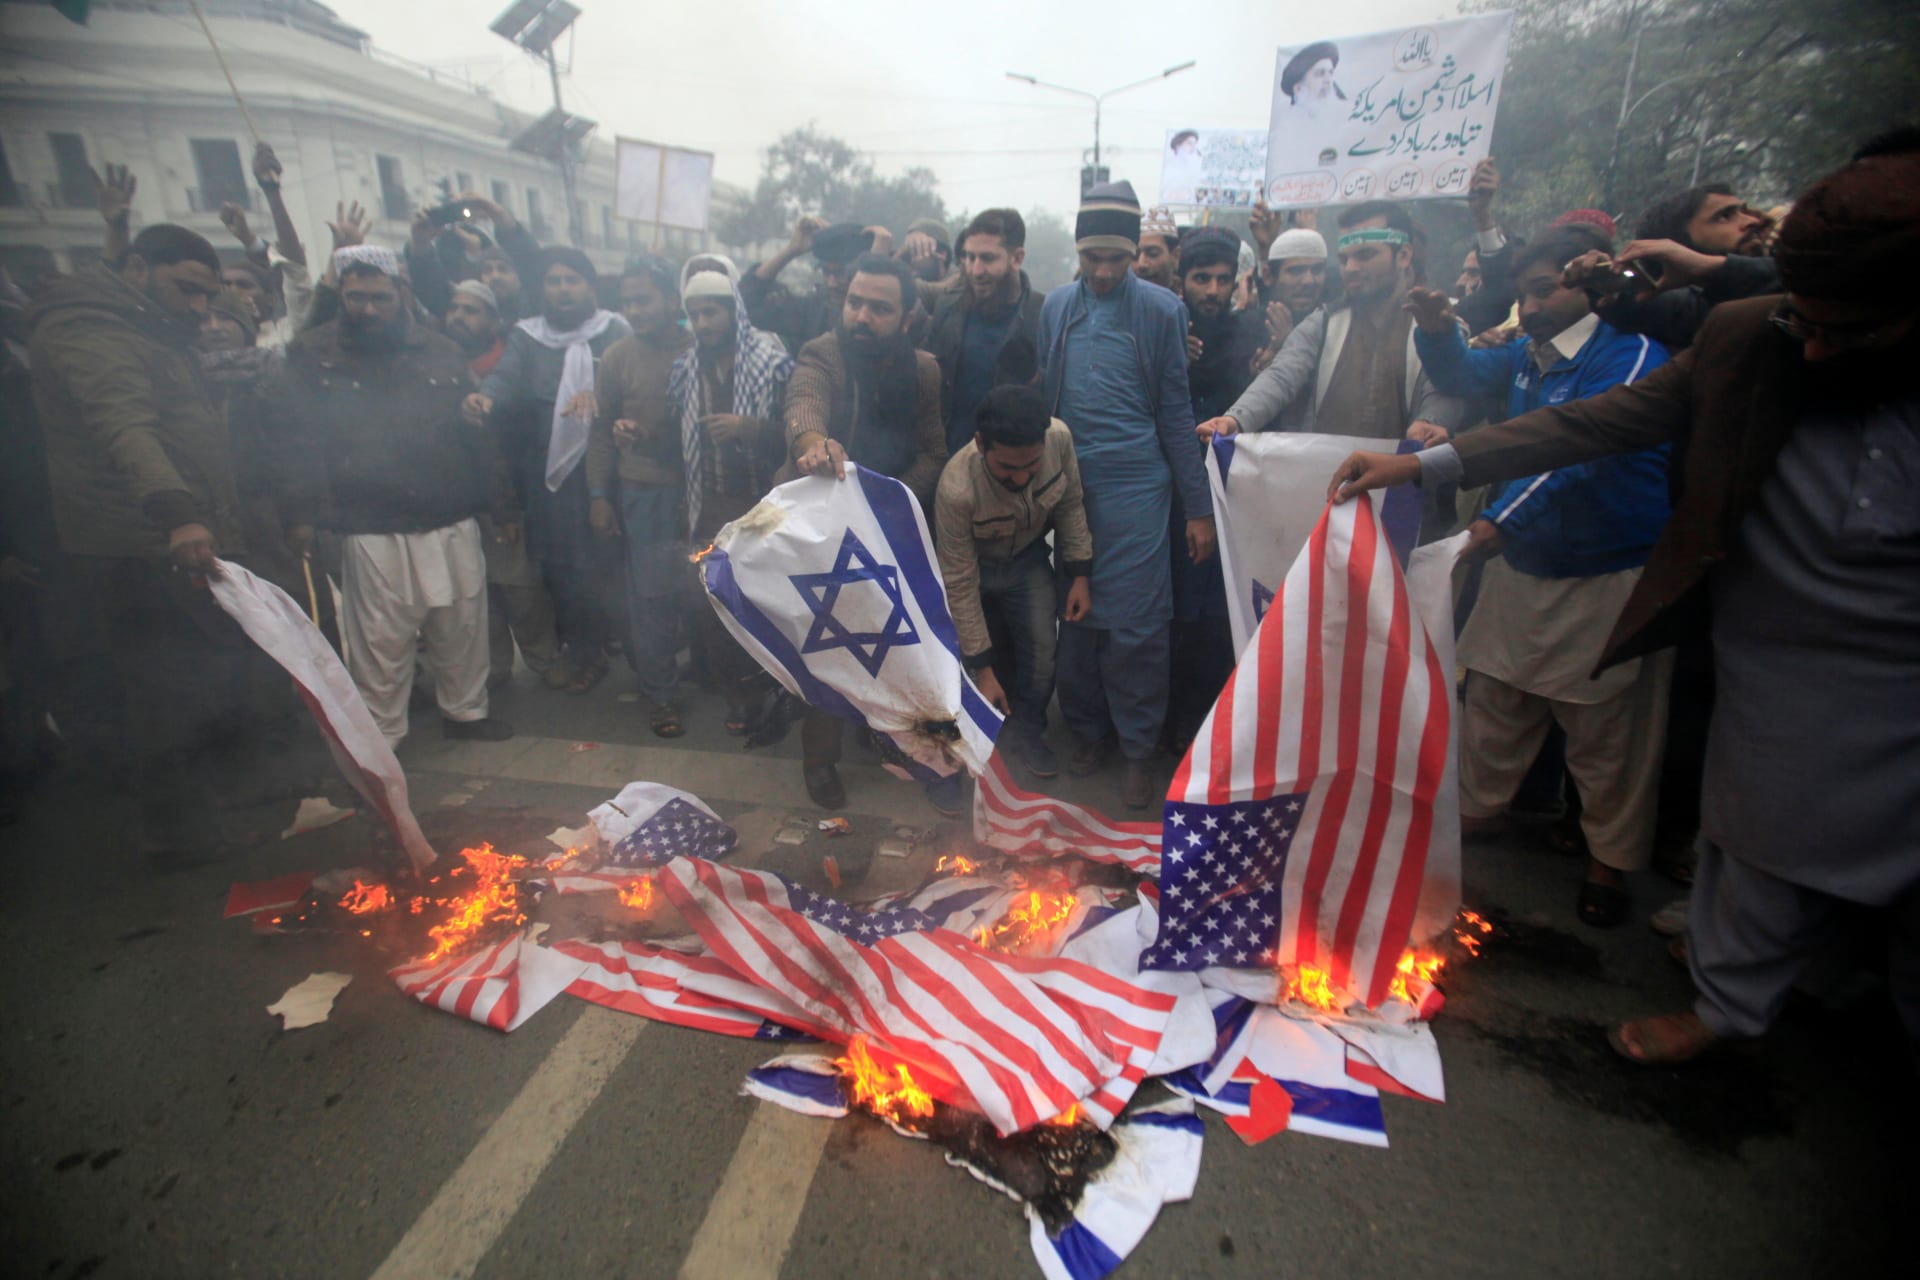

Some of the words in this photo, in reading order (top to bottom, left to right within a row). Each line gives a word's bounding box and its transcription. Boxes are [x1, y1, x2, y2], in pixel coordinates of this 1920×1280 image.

[1348, 75, 1403, 125] امریکہ
[1399, 54, 1456, 121] دشمن
[1451, 73, 1495, 110] اسلام
[1450, 116, 1482, 155] تباہ
[1343, 175, 1372, 196] آمین
[1388, 170, 1419, 193] آمین
[1436, 167, 1468, 189] آمین
